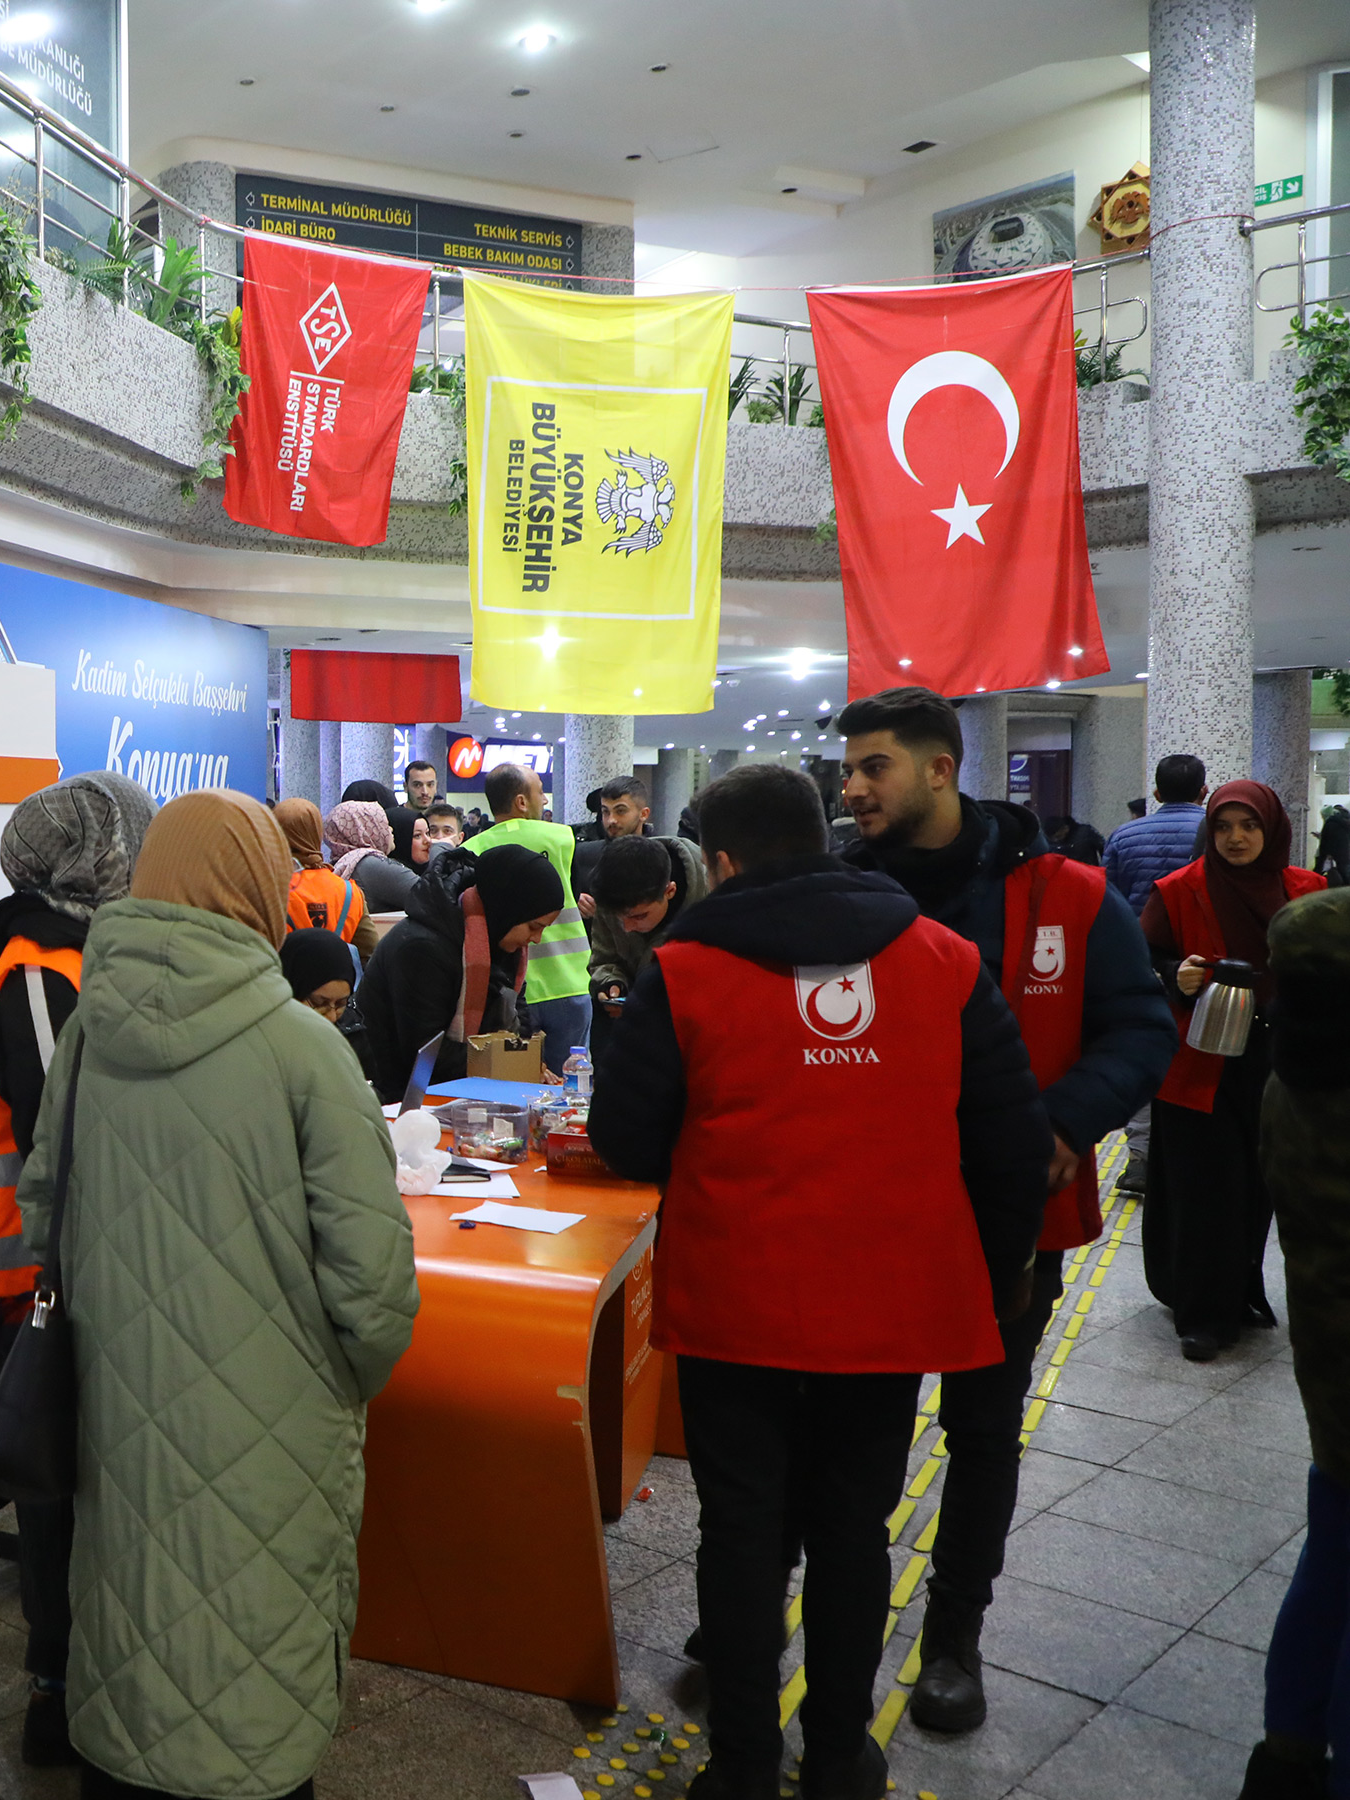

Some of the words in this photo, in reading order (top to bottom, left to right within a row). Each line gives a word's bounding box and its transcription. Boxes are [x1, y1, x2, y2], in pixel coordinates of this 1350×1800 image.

[18, 45, 92, 117] MÜDÜRLÜĞÜ
[261, 193, 328, 216] TERMİNAL
[331, 201, 412, 227] MÜDÜRLÜĞÜ
[261, 215, 297, 236] İDARİ
[300, 222, 336, 241] BÜRO
[474, 223, 518, 242] TEKNİK
[520, 229, 563, 248] SERVİS
[443, 243, 484, 261] BEBEK
[486, 249, 524, 266] BAKIM
[527, 254, 562, 271] ODASI
[309, 305, 341, 352] TSE
[277, 378, 302, 472] ENSTİTÜSÜ
[319, 386, 342, 434] TÜRK
[290, 382, 321, 512] STANDARDLARI
[502, 439, 526, 553] BELEDİYESİ
[522, 402, 562, 593] BÜYÜKŞEHİR
[561, 453, 584, 546] KONYA
[71, 648, 128, 698] Kadim
[132, 659, 190, 710] Selçuklu
[192, 670, 248, 717] Başşehri
[802, 1047, 881, 1065] KONYA
